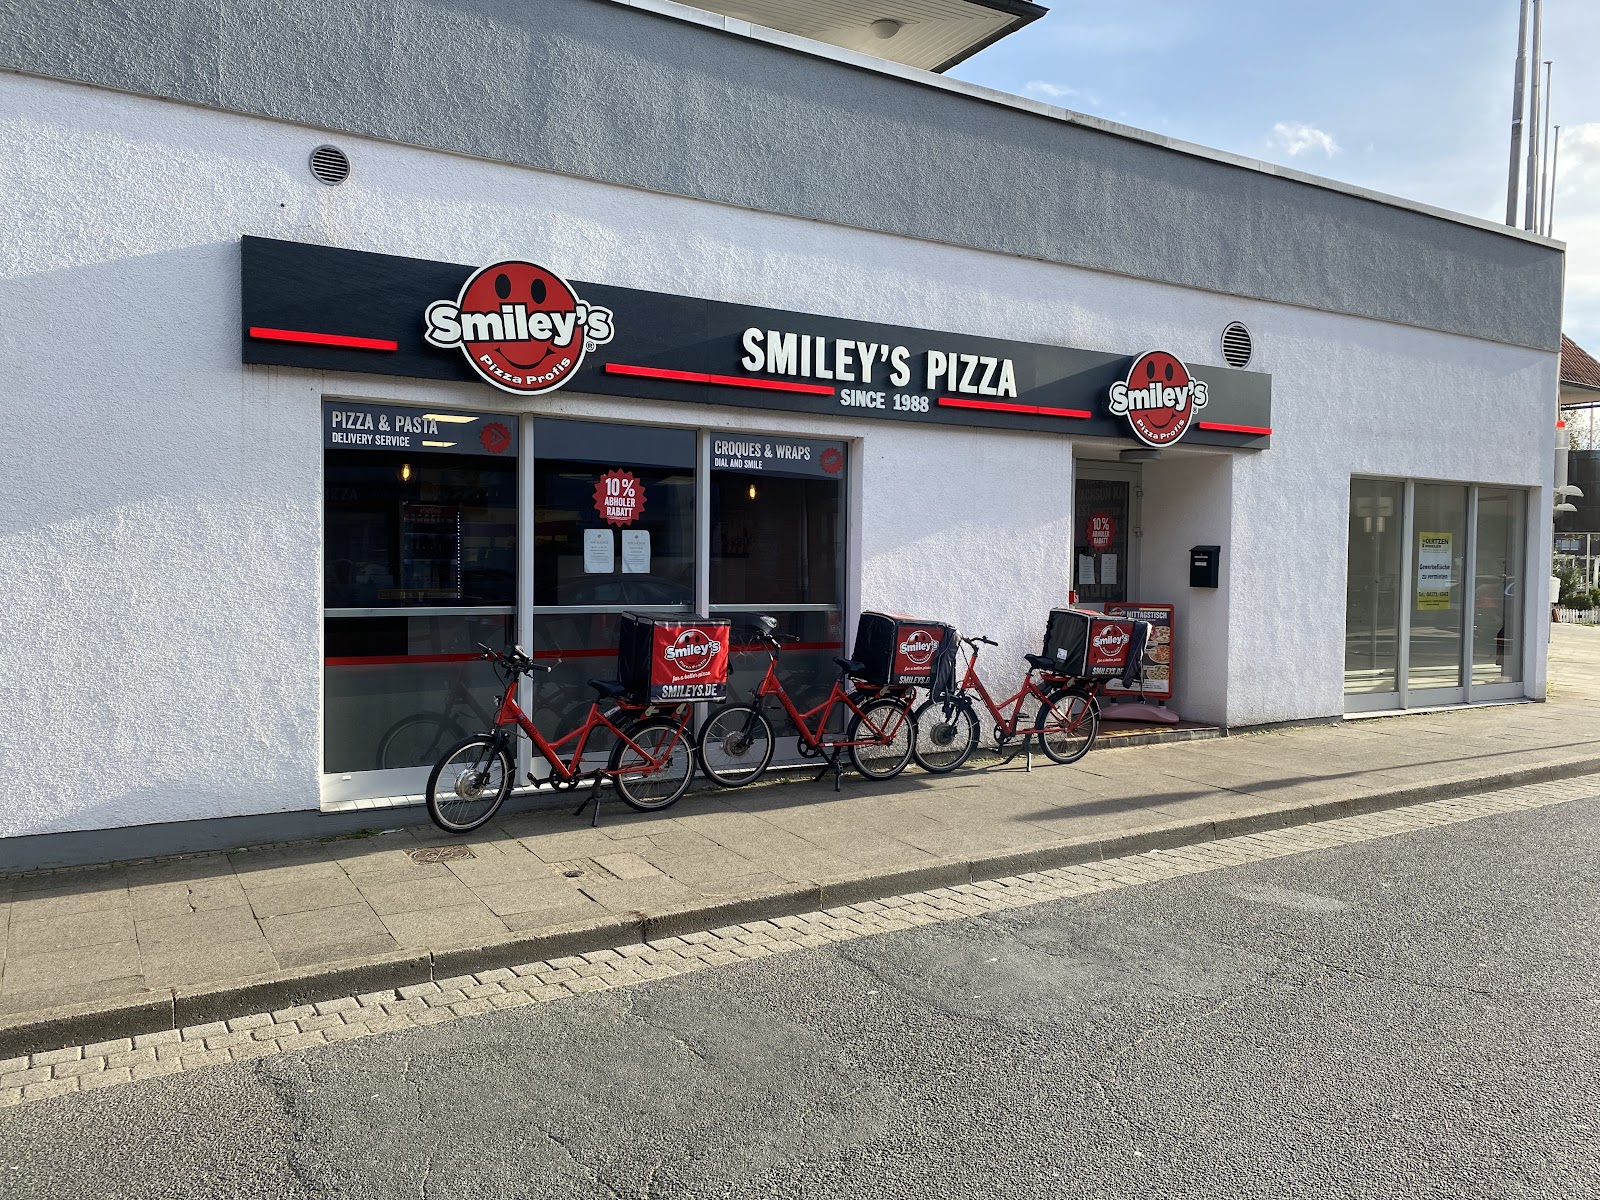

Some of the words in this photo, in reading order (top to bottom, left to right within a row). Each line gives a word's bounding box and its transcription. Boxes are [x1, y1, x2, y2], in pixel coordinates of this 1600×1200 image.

[428, 303, 612, 348] Smiley's
[479, 354, 522, 384] Pizza
[526, 357, 572, 385] Profis
[741, 327, 910, 387] SMILEY'S
[926, 350, 1018, 398] PIZZA
[839, 389, 886, 408] SINCE
[893, 392, 930, 413] 1988
[1111, 380, 1207, 413] Smiley's
[331, 410, 374, 430] PIZZA
[378, 415, 391, 431] &
[395, 415, 439, 435] PASTA
[1136, 419, 1159, 440] Pizza
[1160, 419, 1185, 440] Profis
[331, 432, 373, 445] DELIVERY
[375, 434, 410, 447] SERVICE
[714, 440, 762, 459] CROQUES
[764, 444, 773, 458] &
[776, 444, 811, 460] WRAPS
[714, 457, 729, 468] DIAL
[729, 458, 743, 468] AND
[743, 459, 763, 470] SMILE
[604, 477, 620, 496] 10
[621, 478, 636, 497] %
[604, 497, 636, 508] ABHOLER
[606, 507, 632, 516] RABATT
[1092, 517, 1101, 531] 10
[665, 641, 720, 660] Smiley's
[662, 684, 718, 698] SMILEYS.DE
